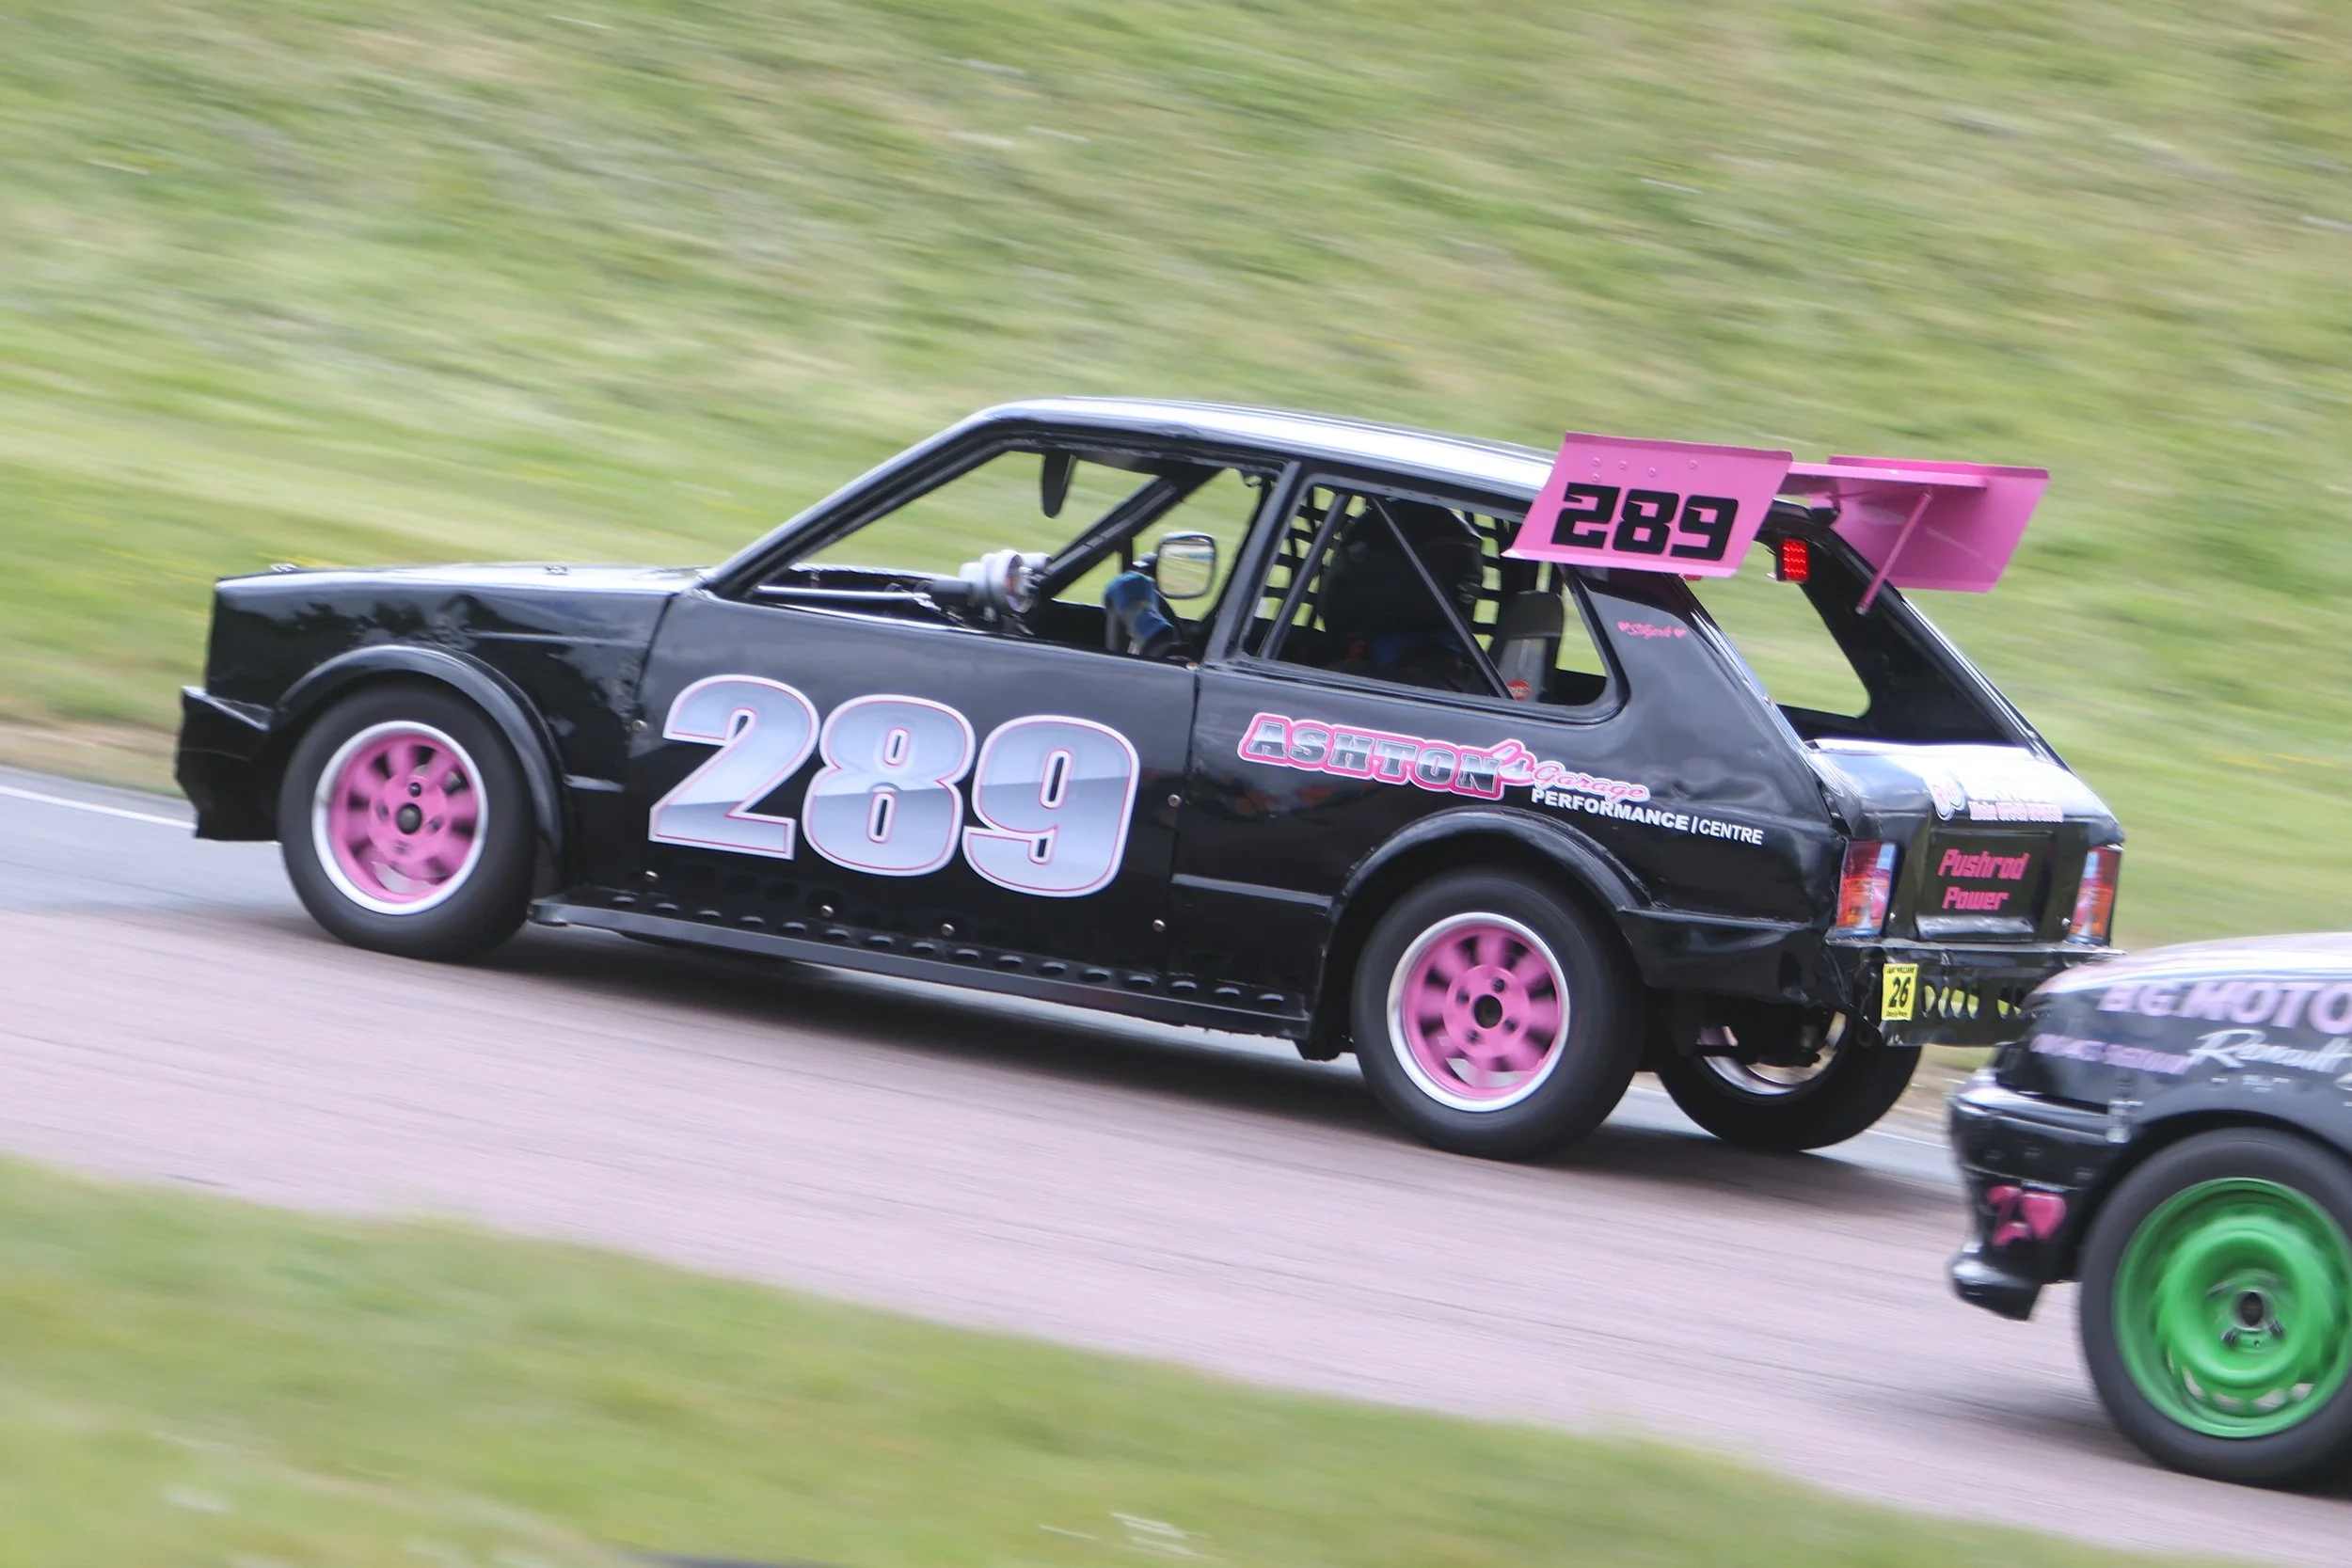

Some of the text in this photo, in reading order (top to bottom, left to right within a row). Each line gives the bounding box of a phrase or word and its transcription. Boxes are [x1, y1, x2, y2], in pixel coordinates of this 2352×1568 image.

[1550, 482, 1740, 562] 289
[648, 673, 1140, 898] 289
[1532, 760, 1651, 804] Garage
[1531, 788, 1765, 846] PERFORMANCE CENTRE
[1938, 848, 2031, 879] Pushrod
[1942, 886, 2010, 911] Power
[1888, 975, 1912, 1008] 26
